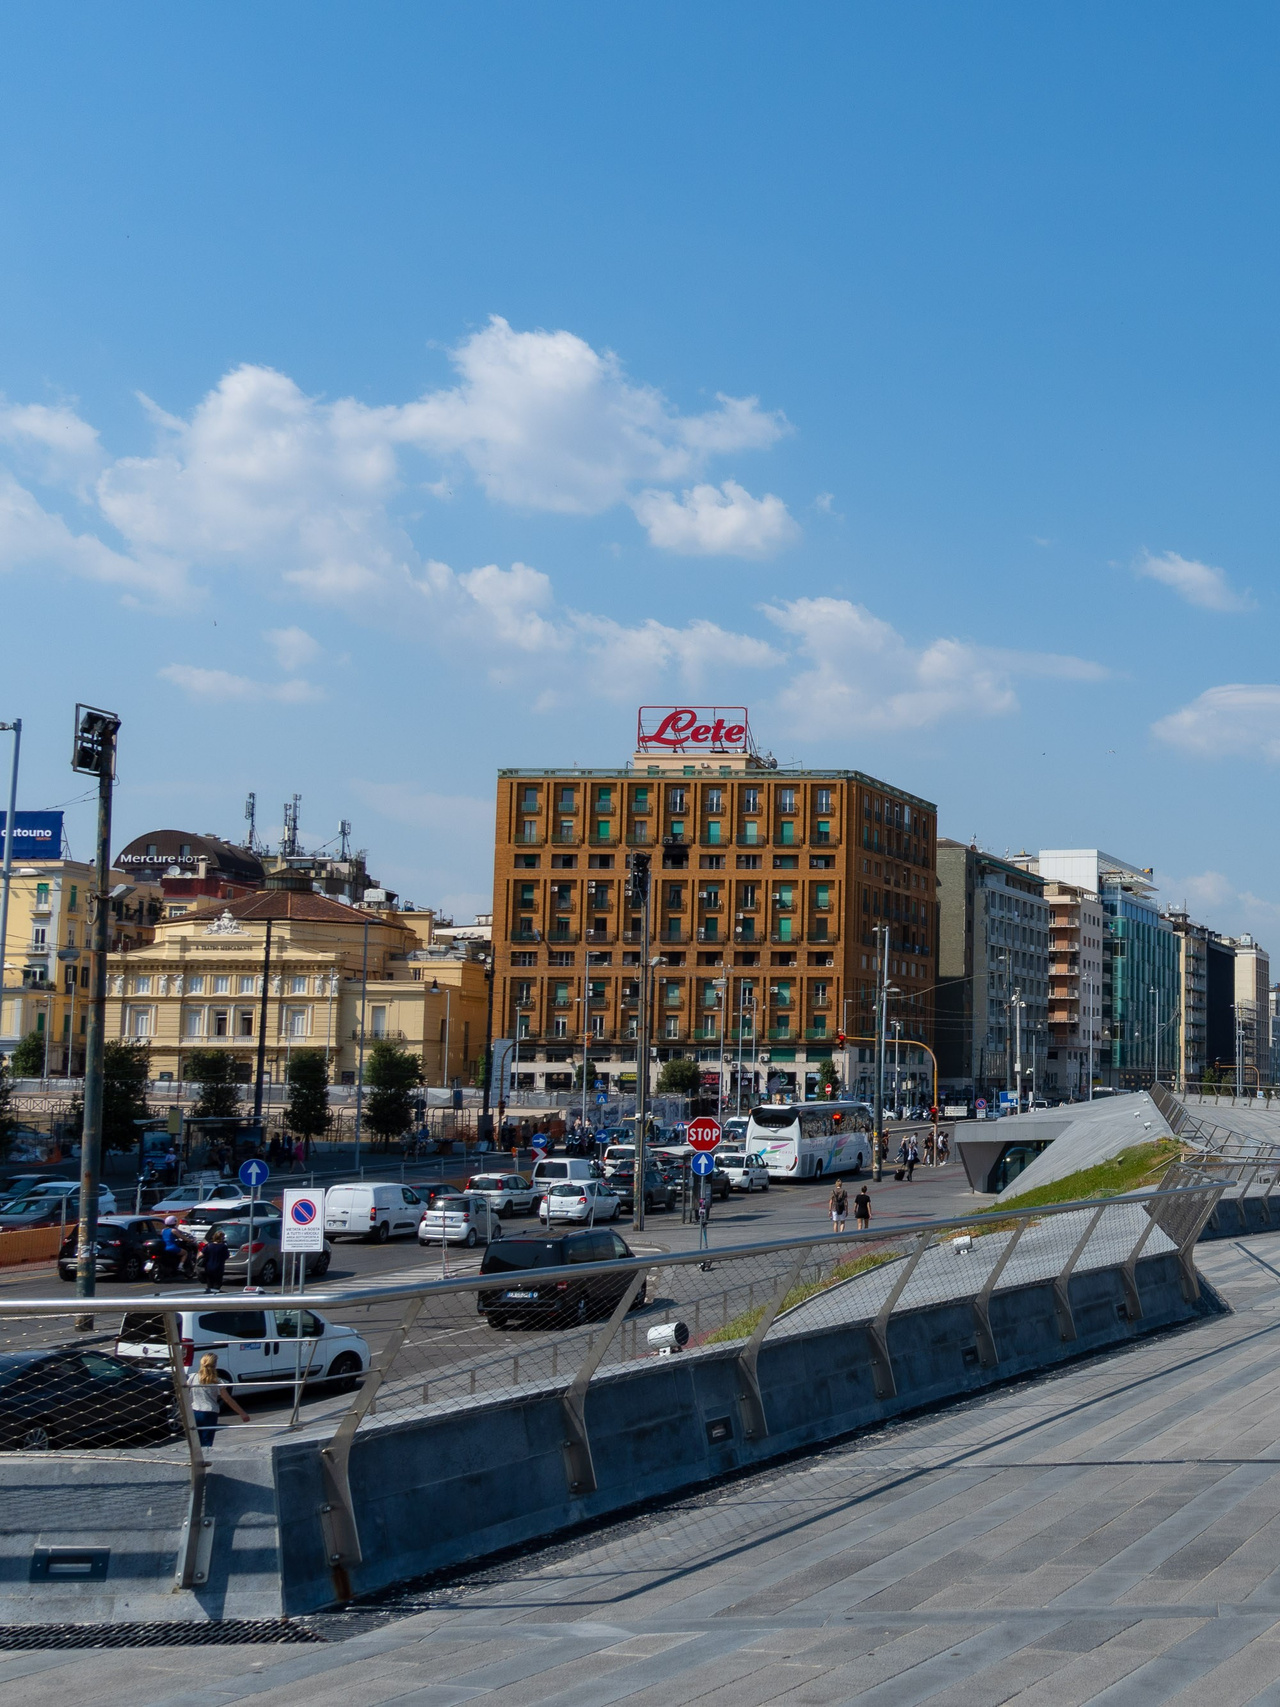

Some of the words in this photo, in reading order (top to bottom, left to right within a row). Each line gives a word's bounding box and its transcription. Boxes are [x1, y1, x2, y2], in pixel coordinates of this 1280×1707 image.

[640, 709, 745, 746] Lete
[120, 854, 176, 863] Mercure
[178, 855, 202, 863] HOT
[689, 1128, 720, 1141] STOP
